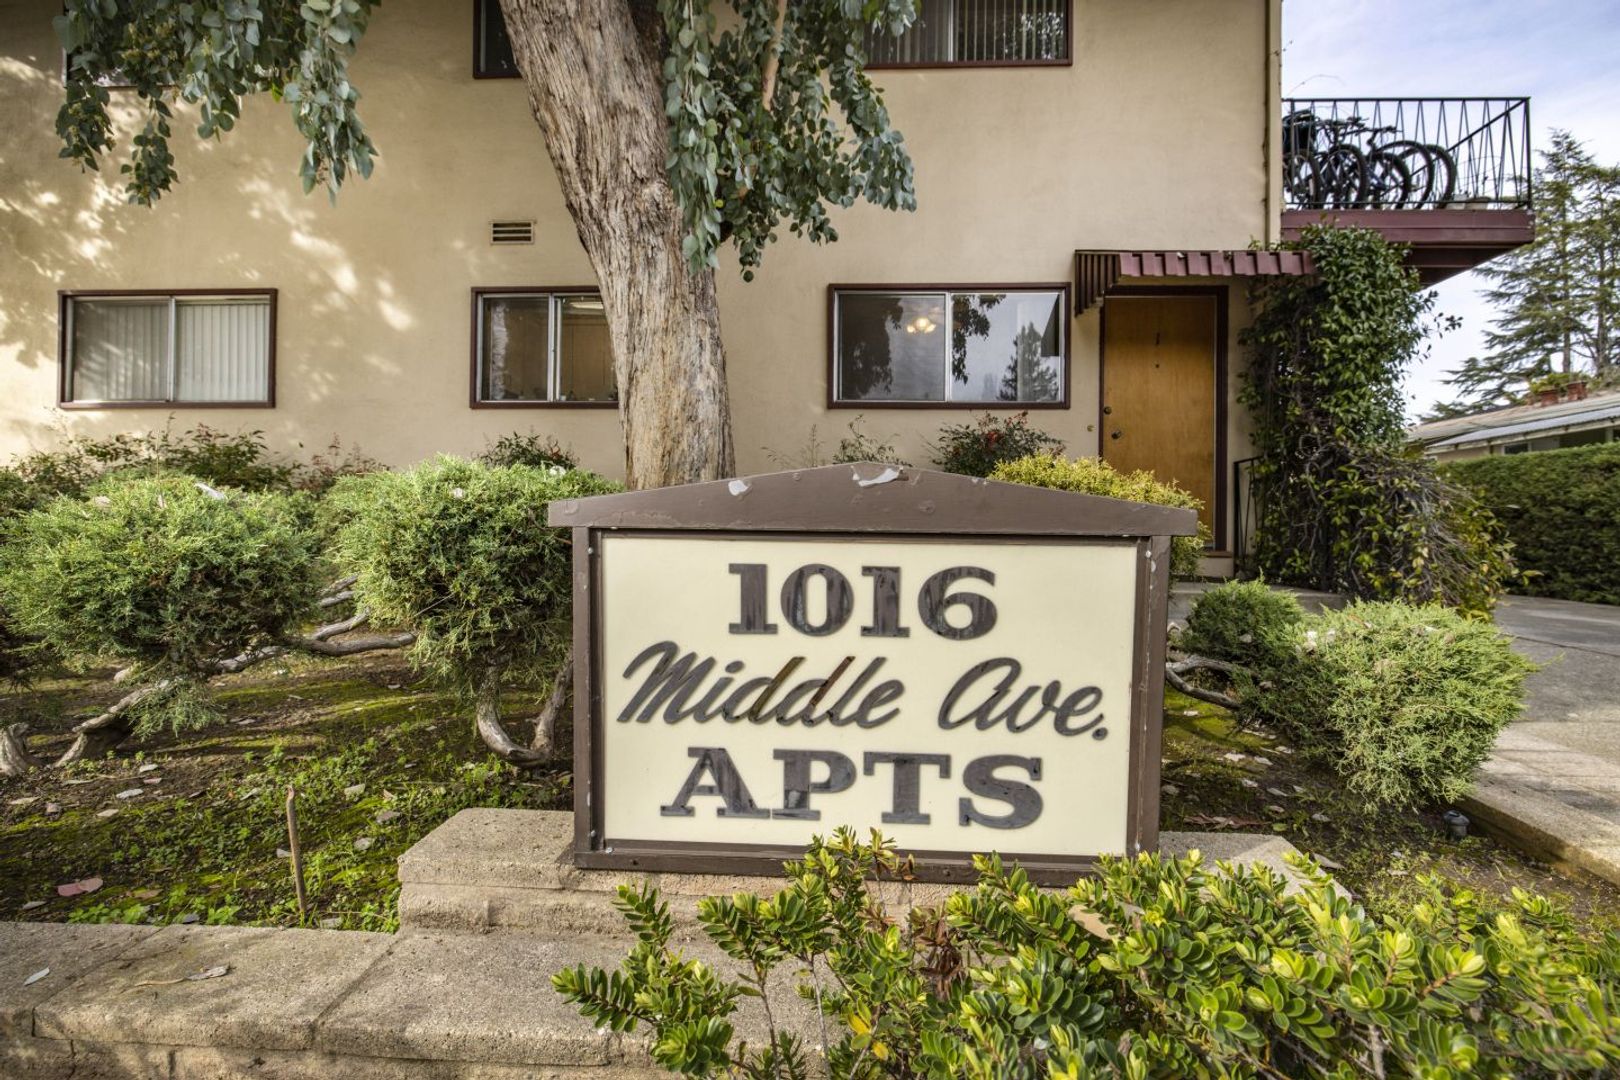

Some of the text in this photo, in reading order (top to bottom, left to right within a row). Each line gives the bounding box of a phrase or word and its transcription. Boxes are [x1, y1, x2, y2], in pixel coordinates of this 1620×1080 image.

[728, 563, 998, 640] 1016
[616, 640, 1108, 741] Middle Ave.
[660, 747, 1043, 830] APTS
